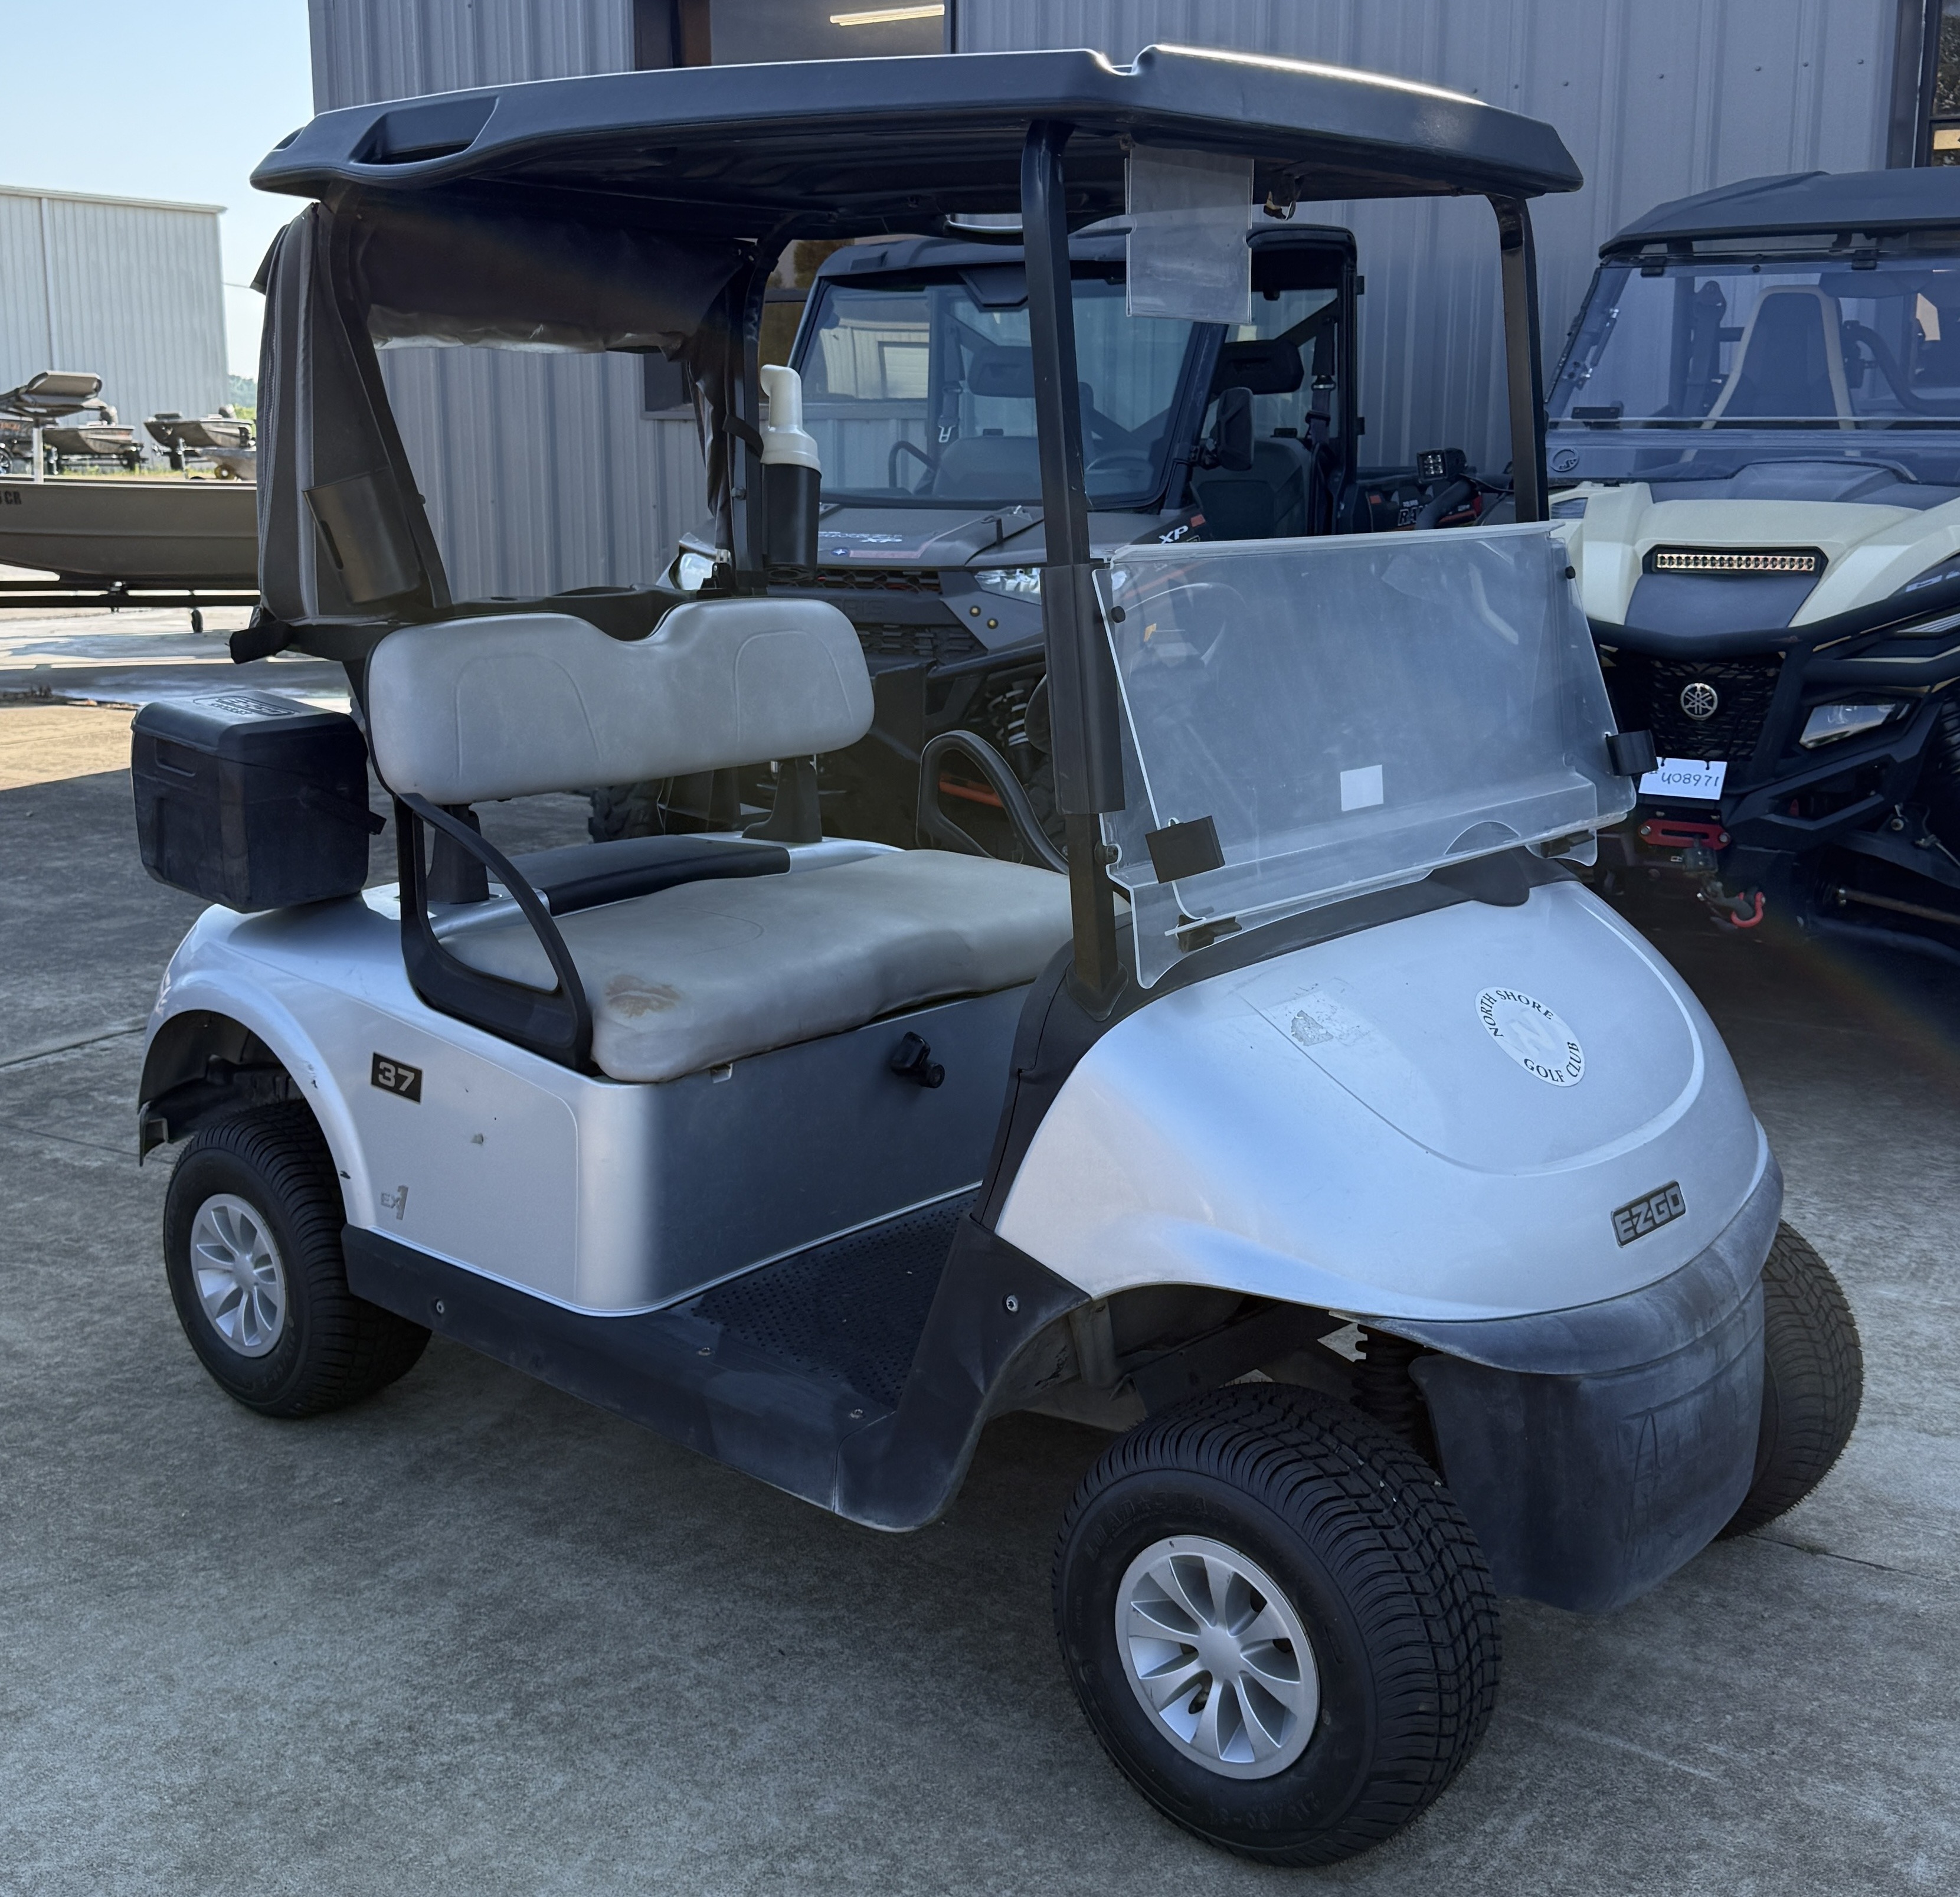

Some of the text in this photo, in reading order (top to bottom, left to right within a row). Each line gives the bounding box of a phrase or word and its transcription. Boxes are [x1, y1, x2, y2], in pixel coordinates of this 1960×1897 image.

[1159, 525, 1189, 544] XP
[1480, 990, 1554, 1038] NORTH SHORE
[378, 1061, 415, 1091] 37
[1523, 1041, 1582, 1082] GOLF CLUB
